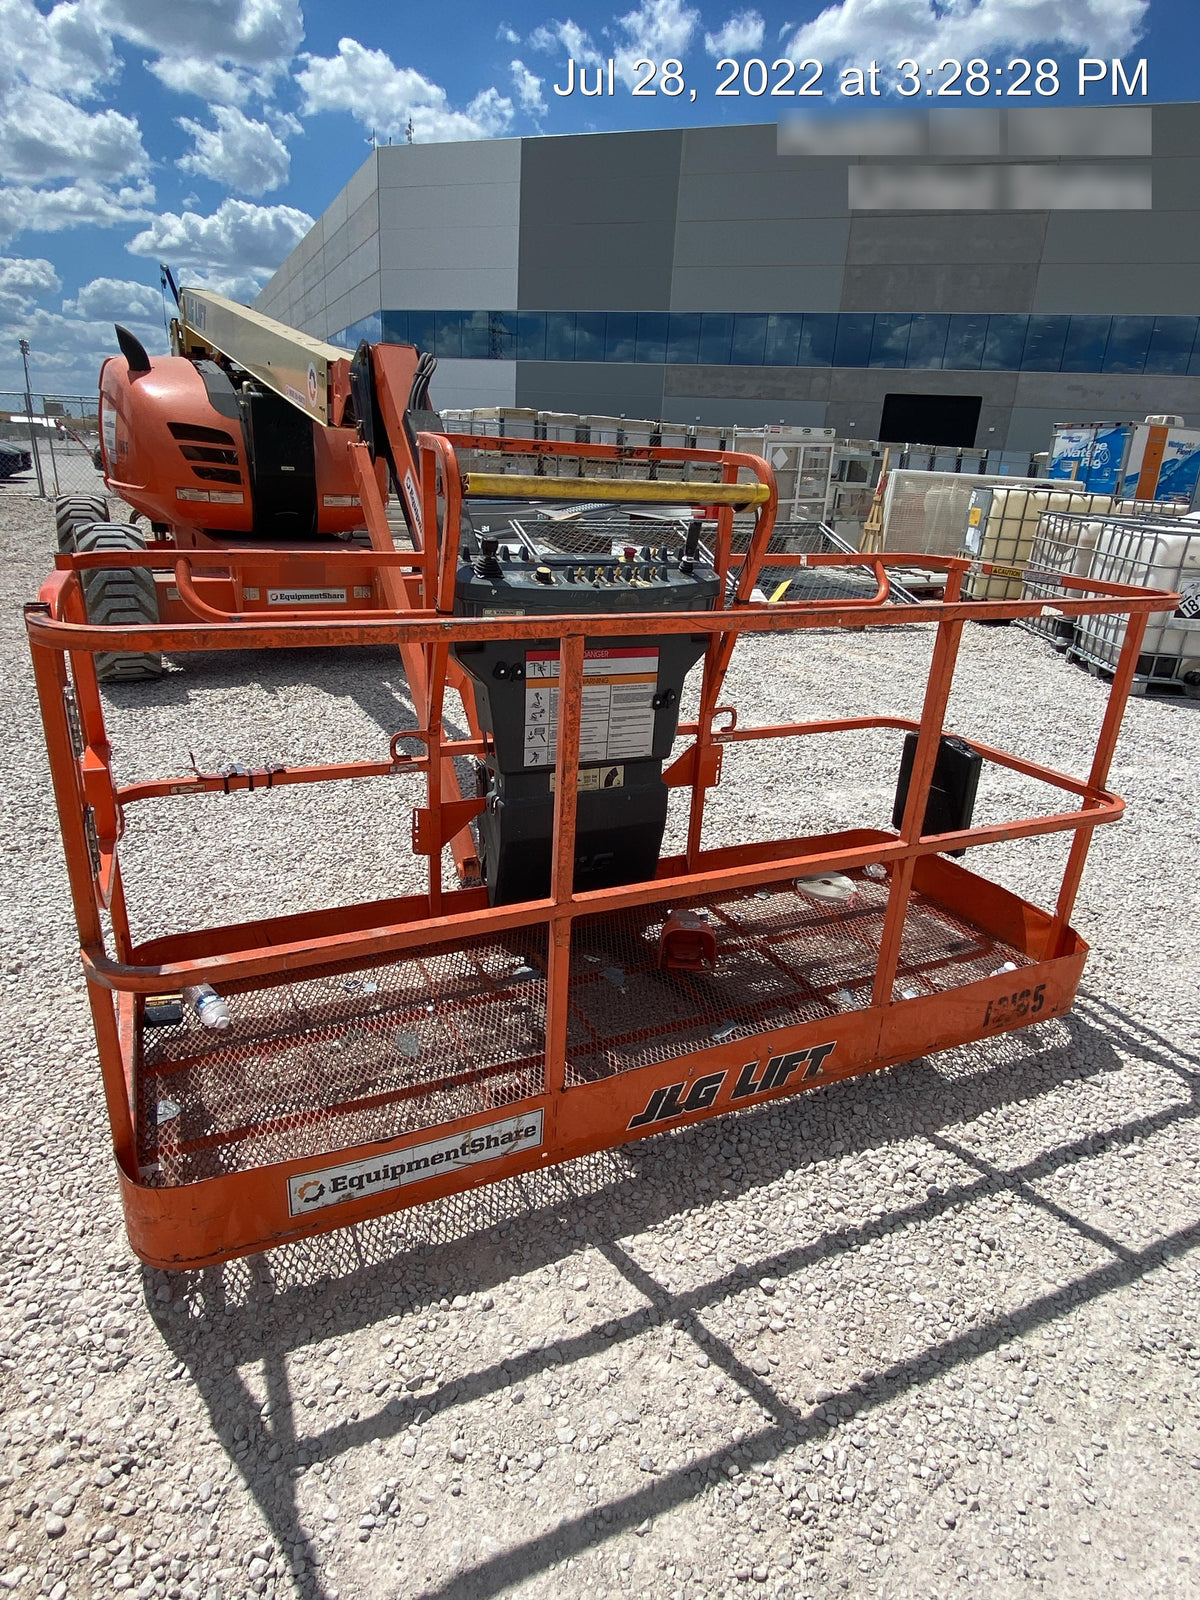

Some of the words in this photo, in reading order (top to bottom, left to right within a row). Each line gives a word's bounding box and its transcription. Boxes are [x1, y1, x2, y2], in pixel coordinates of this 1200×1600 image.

[1087, 441, 1108, 451] The
[1062, 447, 1101, 458] Water
[279, 592, 345, 603] EquipmentShare
[625, 1069, 729, 1131] JLG
[730, 1040, 838, 1100] LIFT
[330, 1124, 537, 1194] EquipmentShare
